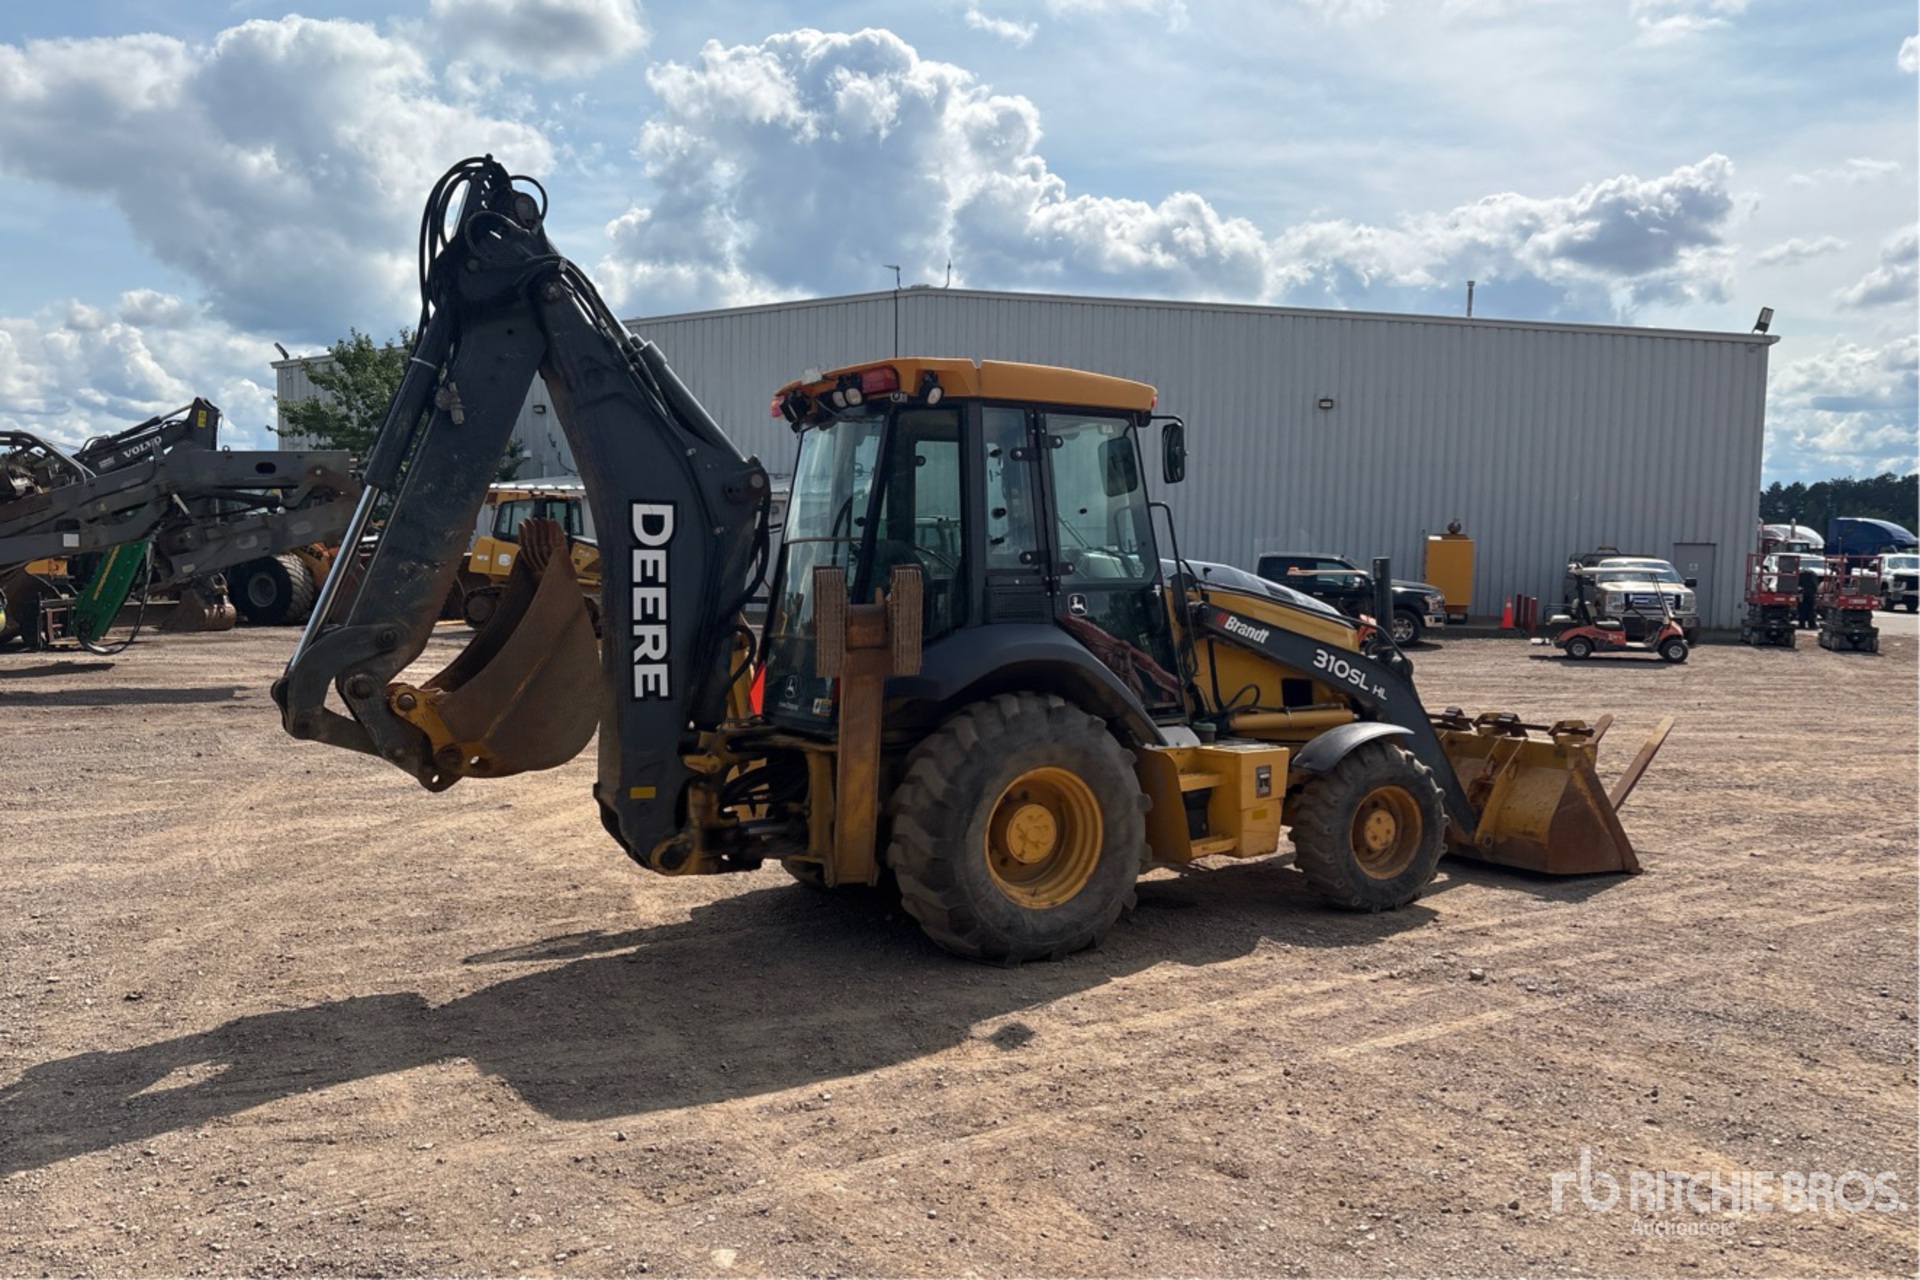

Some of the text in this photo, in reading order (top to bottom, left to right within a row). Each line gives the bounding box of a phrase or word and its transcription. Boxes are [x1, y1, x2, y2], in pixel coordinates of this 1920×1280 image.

[632, 503, 674, 698] DEERE
[1224, 616, 1269, 644] Brandt
[1313, 648, 1387, 700] 310SL HL
